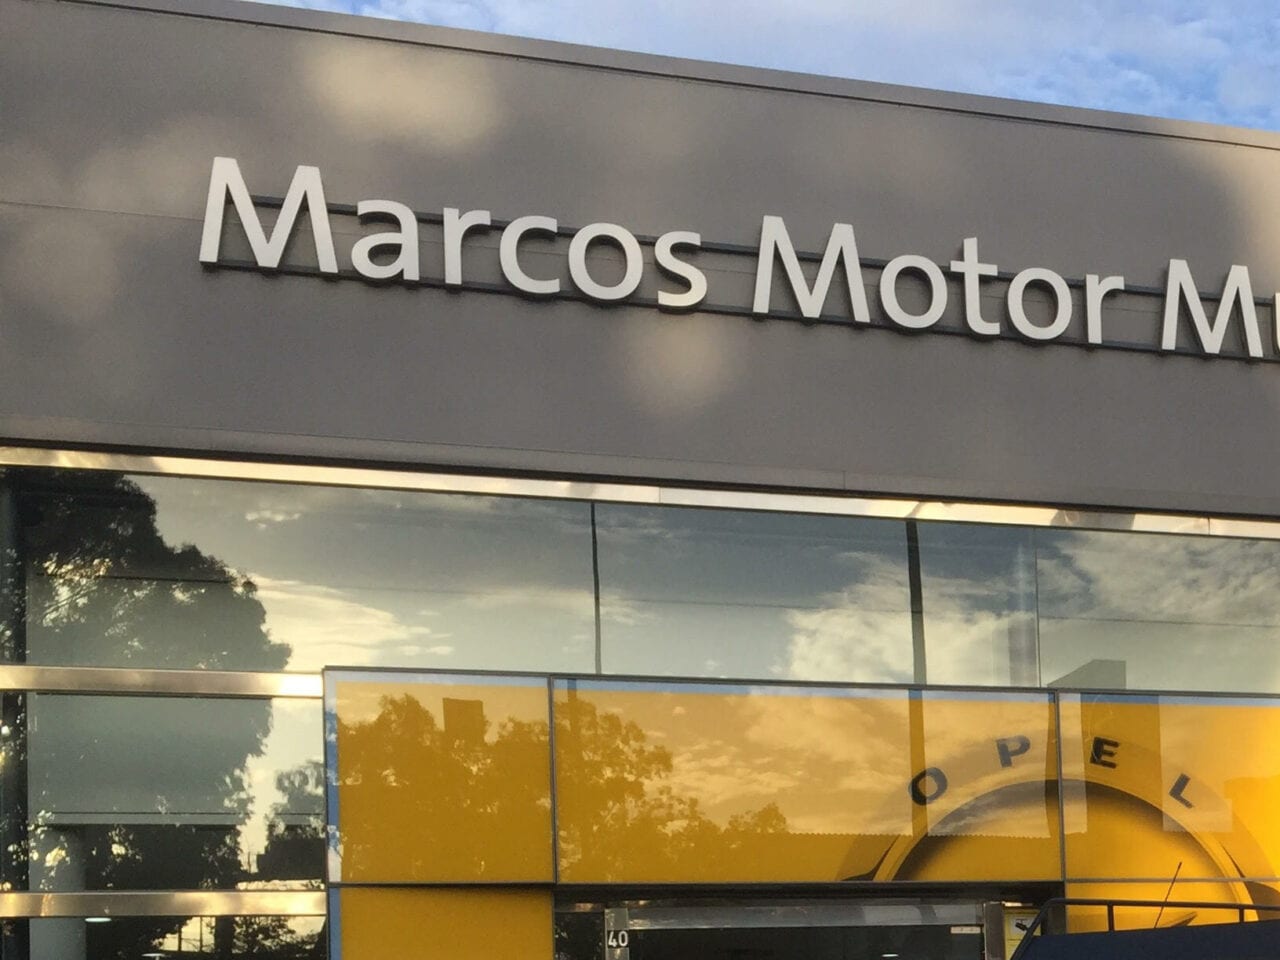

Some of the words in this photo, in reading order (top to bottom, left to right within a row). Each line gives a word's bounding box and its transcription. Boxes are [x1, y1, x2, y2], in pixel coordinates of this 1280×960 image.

[199, 157, 708, 308] Marcos
[752, 214, 1125, 344] Motor
[908, 734, 1194, 809] OPEL
[608, 931, 628, 947] 40
